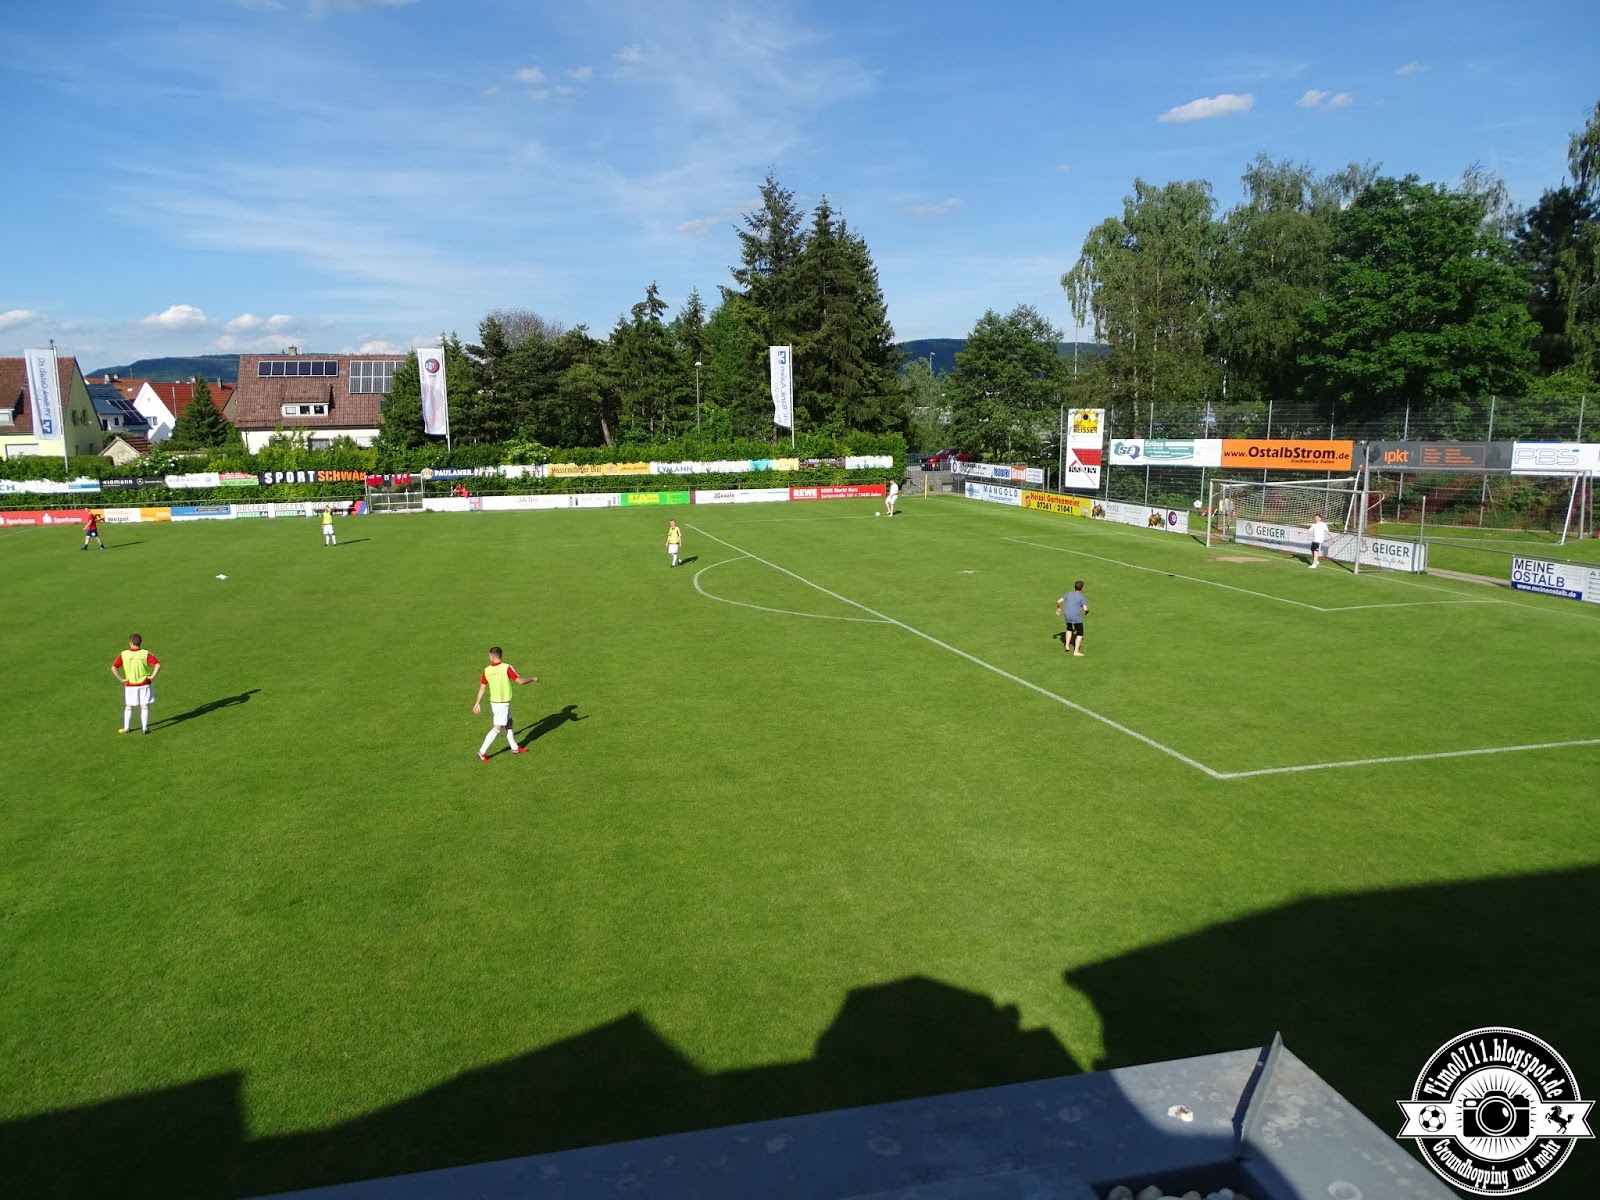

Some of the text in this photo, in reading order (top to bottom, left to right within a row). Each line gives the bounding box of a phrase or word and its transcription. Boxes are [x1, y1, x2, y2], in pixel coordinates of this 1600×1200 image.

[1073, 426, 1098, 434] REISSER
[1223, 446, 1350, 459] www.OstalbStrom.de
[1514, 447, 1579, 465] PBS
[657, 465, 693, 473] EYMANN
[264, 471, 316, 484] SPORT
[793, 488, 818, 497] REWE
[53, 516, 83, 524] Sparkasse
[1256, 525, 1286, 539] GEIGER
[1372, 542, 1410, 558] GEIGER
[1514, 558, 1555, 575] MEINE
[1513, 570, 1565, 588] OSTALB
[1516, 583, 1577, 598] www.meineostalb.de
